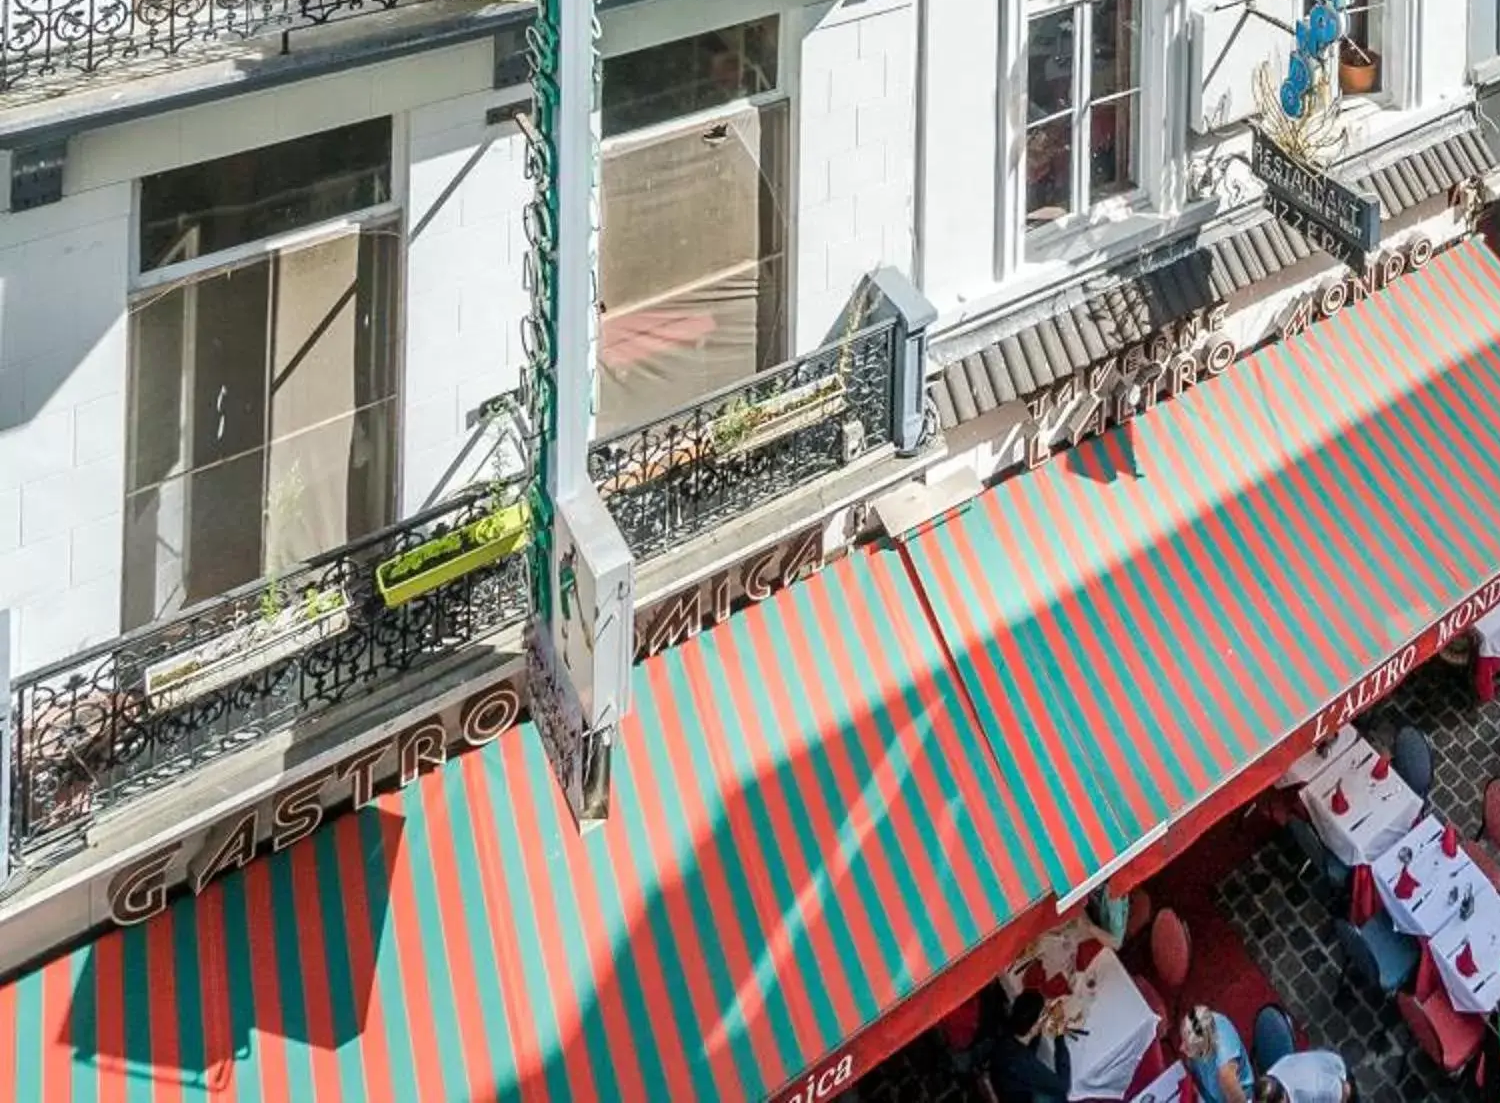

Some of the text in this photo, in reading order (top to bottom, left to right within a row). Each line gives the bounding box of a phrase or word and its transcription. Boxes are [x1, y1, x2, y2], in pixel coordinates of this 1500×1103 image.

[1283, 237, 1433, 341] MONDO
[1026, 302, 1231, 420] TAVERNE
[1311, 645, 1416, 744] L'ALTRO
